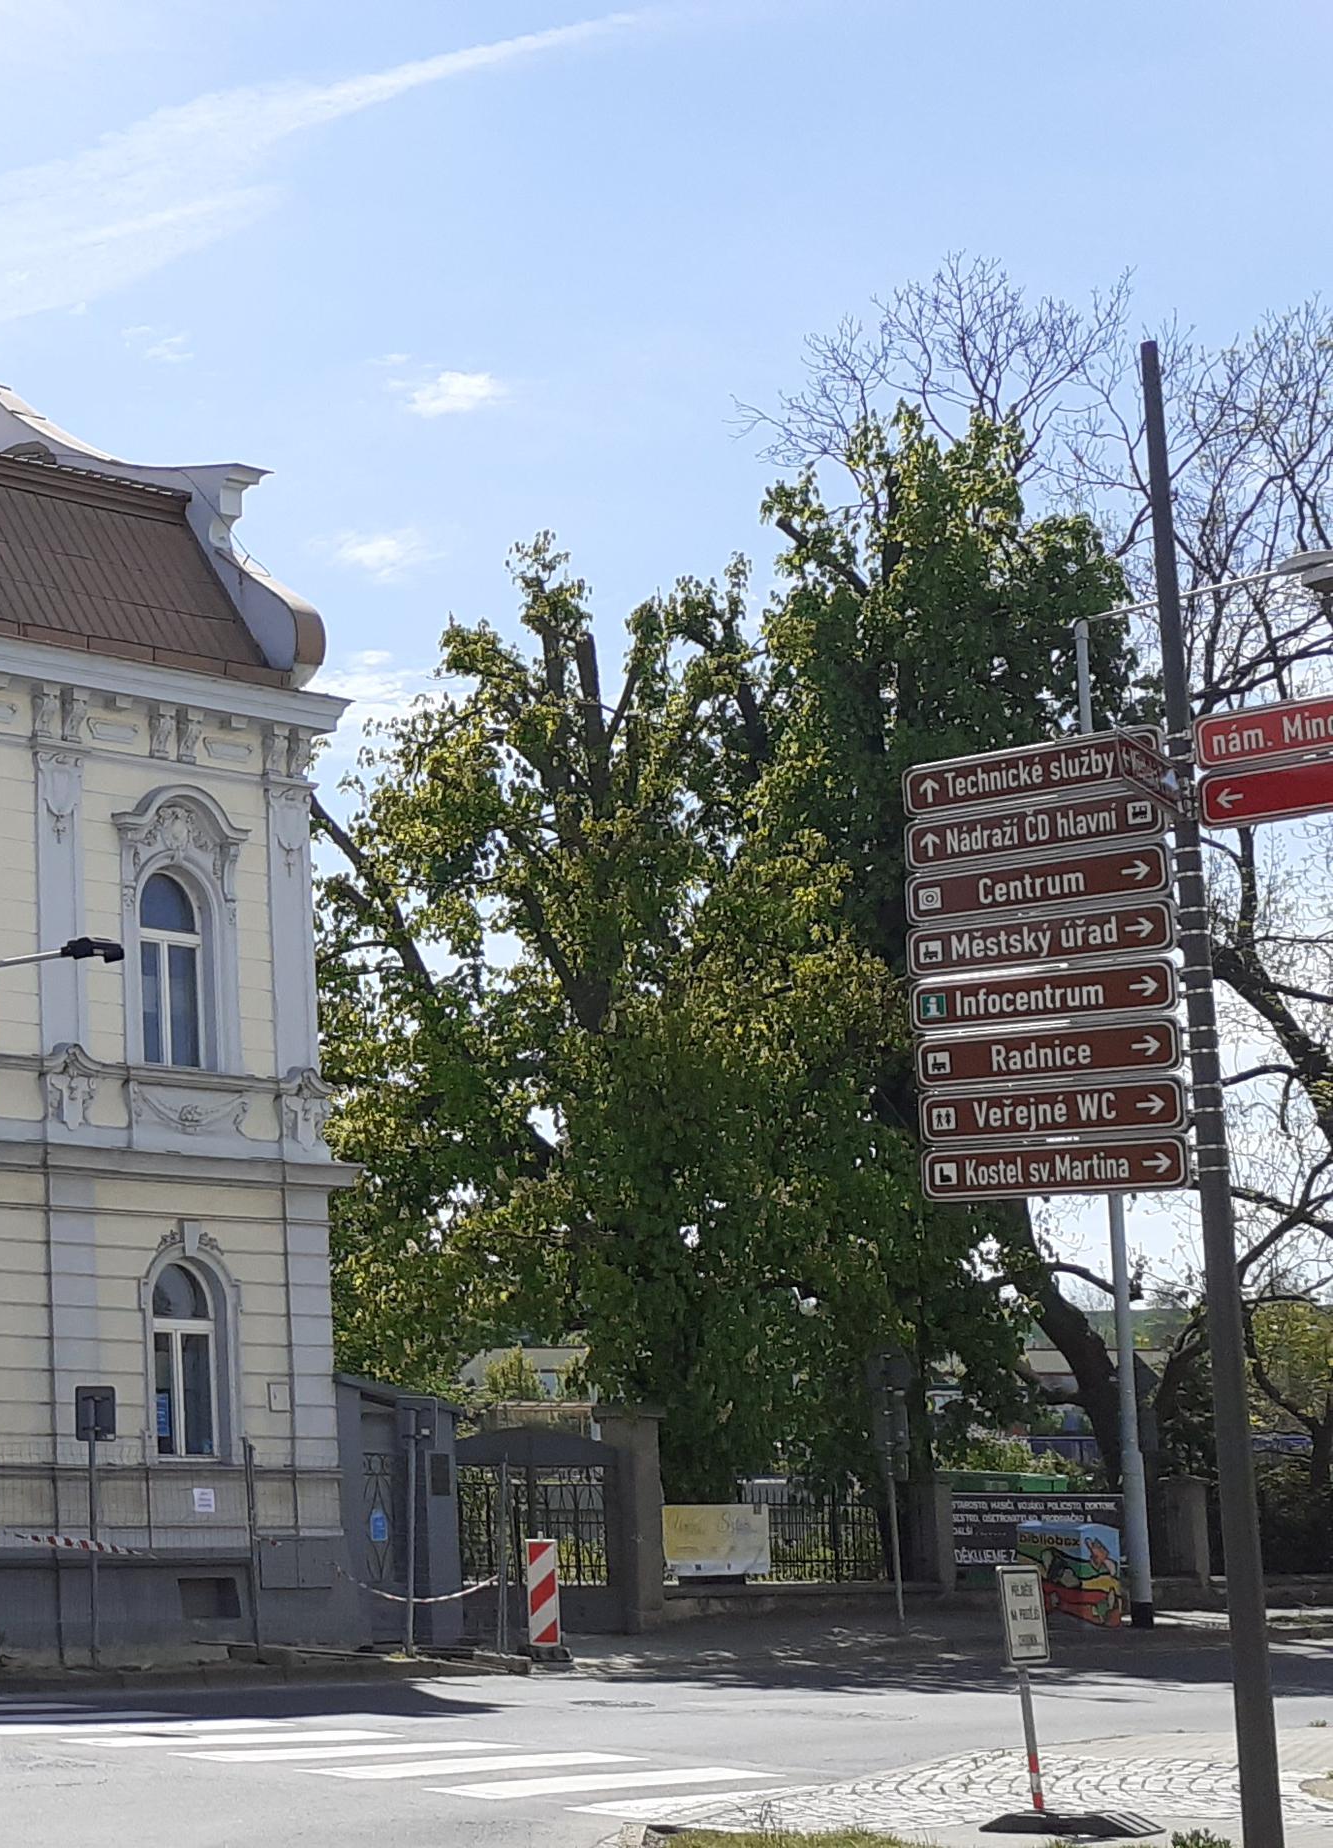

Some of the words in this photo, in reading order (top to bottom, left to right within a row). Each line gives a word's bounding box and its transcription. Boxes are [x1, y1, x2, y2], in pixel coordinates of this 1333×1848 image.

[1212, 724, 1273, 756] nám.
[944, 756, 1044, 798] Technické
[1049, 748, 1115, 782] služby
[945, 817, 1019, 854] Nádraží
[1024, 808, 1050, 843] ČD
[1056, 802, 1117, 838] hlavní
[978, 872, 1085, 904] Centrum
[950, 920, 1052, 961] Městský
[1060, 915, 1118, 948] úřad
[955, 983, 1104, 1016] Infocentrum
[990, 1039, 1092, 1072] Radnice
[973, 1095, 1068, 1131] Veřejné
[1076, 1091, 1117, 1121] WC
[965, 1156, 1024, 1186] Kostel
[1029, 1152, 1130, 1183] sv.Martina
[953, 1546, 1010, 1563] DĚKUJEME
[1019, 1532, 1081, 1546] bibliobox
